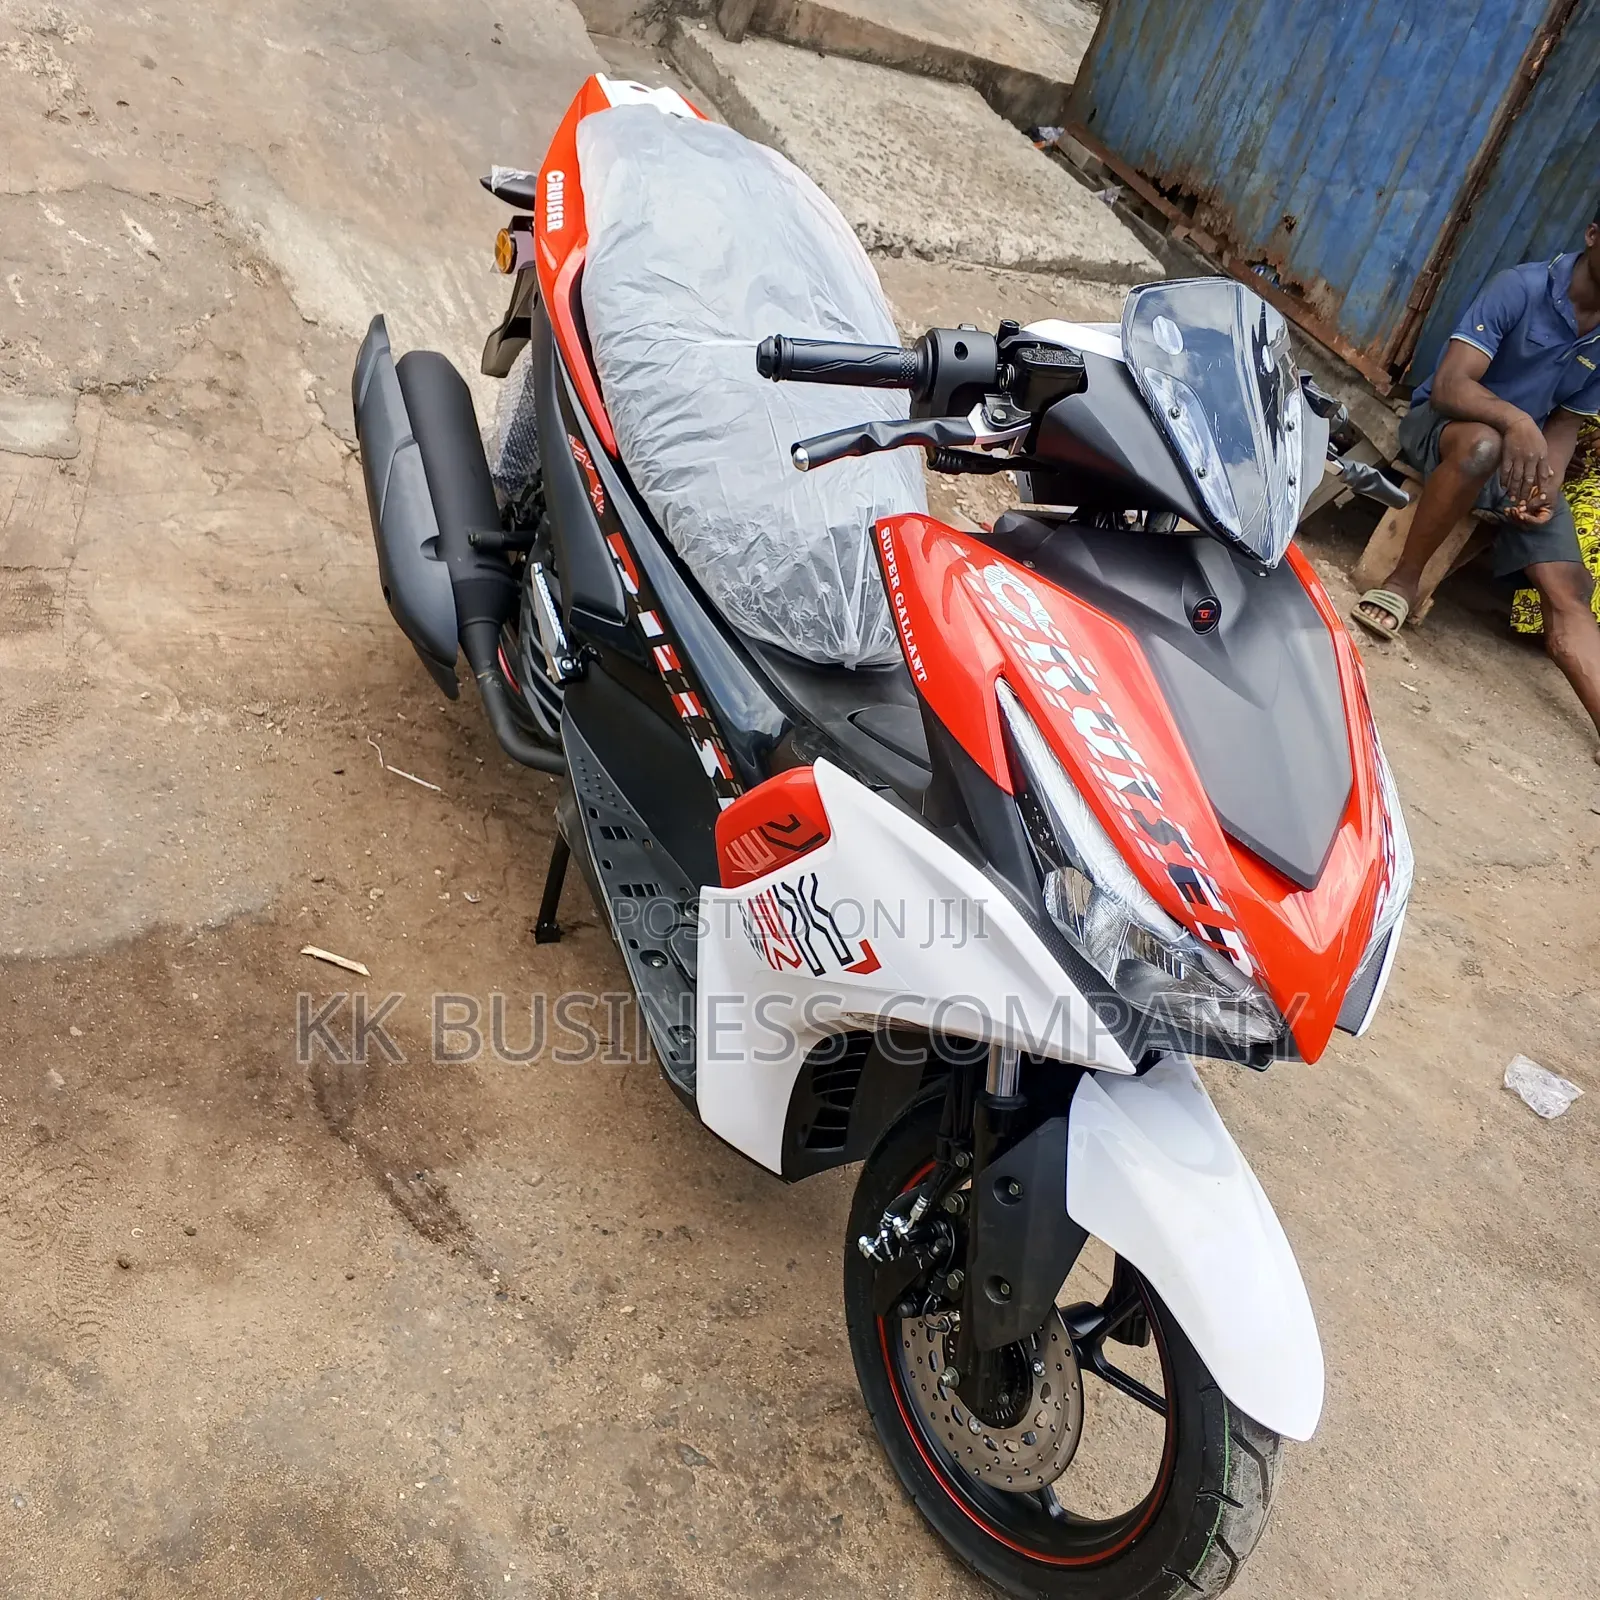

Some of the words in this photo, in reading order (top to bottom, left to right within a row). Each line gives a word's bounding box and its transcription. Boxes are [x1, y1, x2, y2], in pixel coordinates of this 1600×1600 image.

[546, 170, 565, 233] CRUISER
[880, 526, 901, 591] SUPER
[894, 591, 929, 684] GALLANT
[981, 559, 1254, 978] CRUISER
